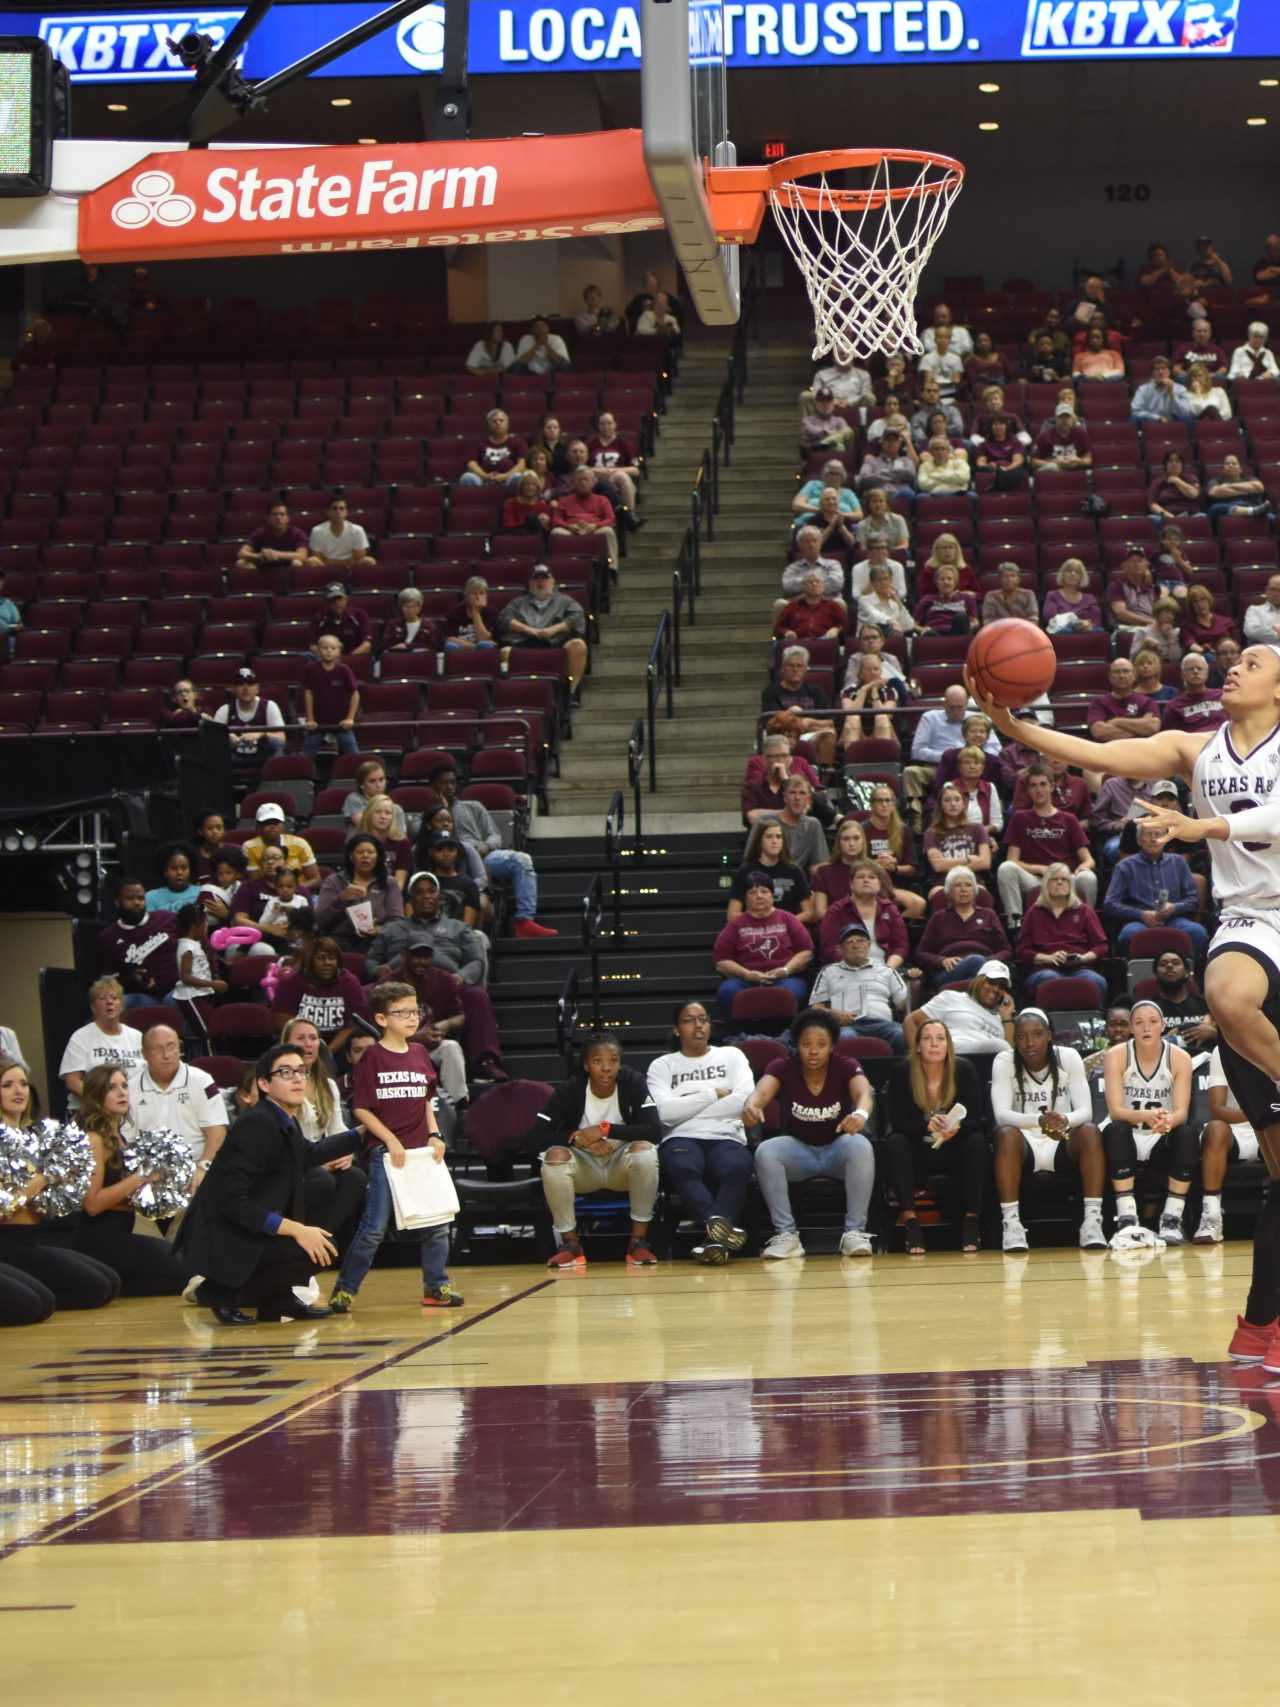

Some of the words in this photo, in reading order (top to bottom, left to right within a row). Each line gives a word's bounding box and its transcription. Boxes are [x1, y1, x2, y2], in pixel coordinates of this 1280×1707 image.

[499, 6, 641, 61] LOCA
[721, 1, 980, 57] TRUSTED.
[1032, 0, 1182, 47] KBTX
[51, 22, 193, 72] KBTX
[203, 164, 352, 223] State
[356, 160, 498, 216] Farm
[1104, 184, 1151, 202] 120
[1201, 776, 1249, 798] TEXAS
[1254, 774, 1277, 794] A&
[378, 1071, 409, 1084] TEXAS
[1125, 1086, 1152, 1099] TEXAS
